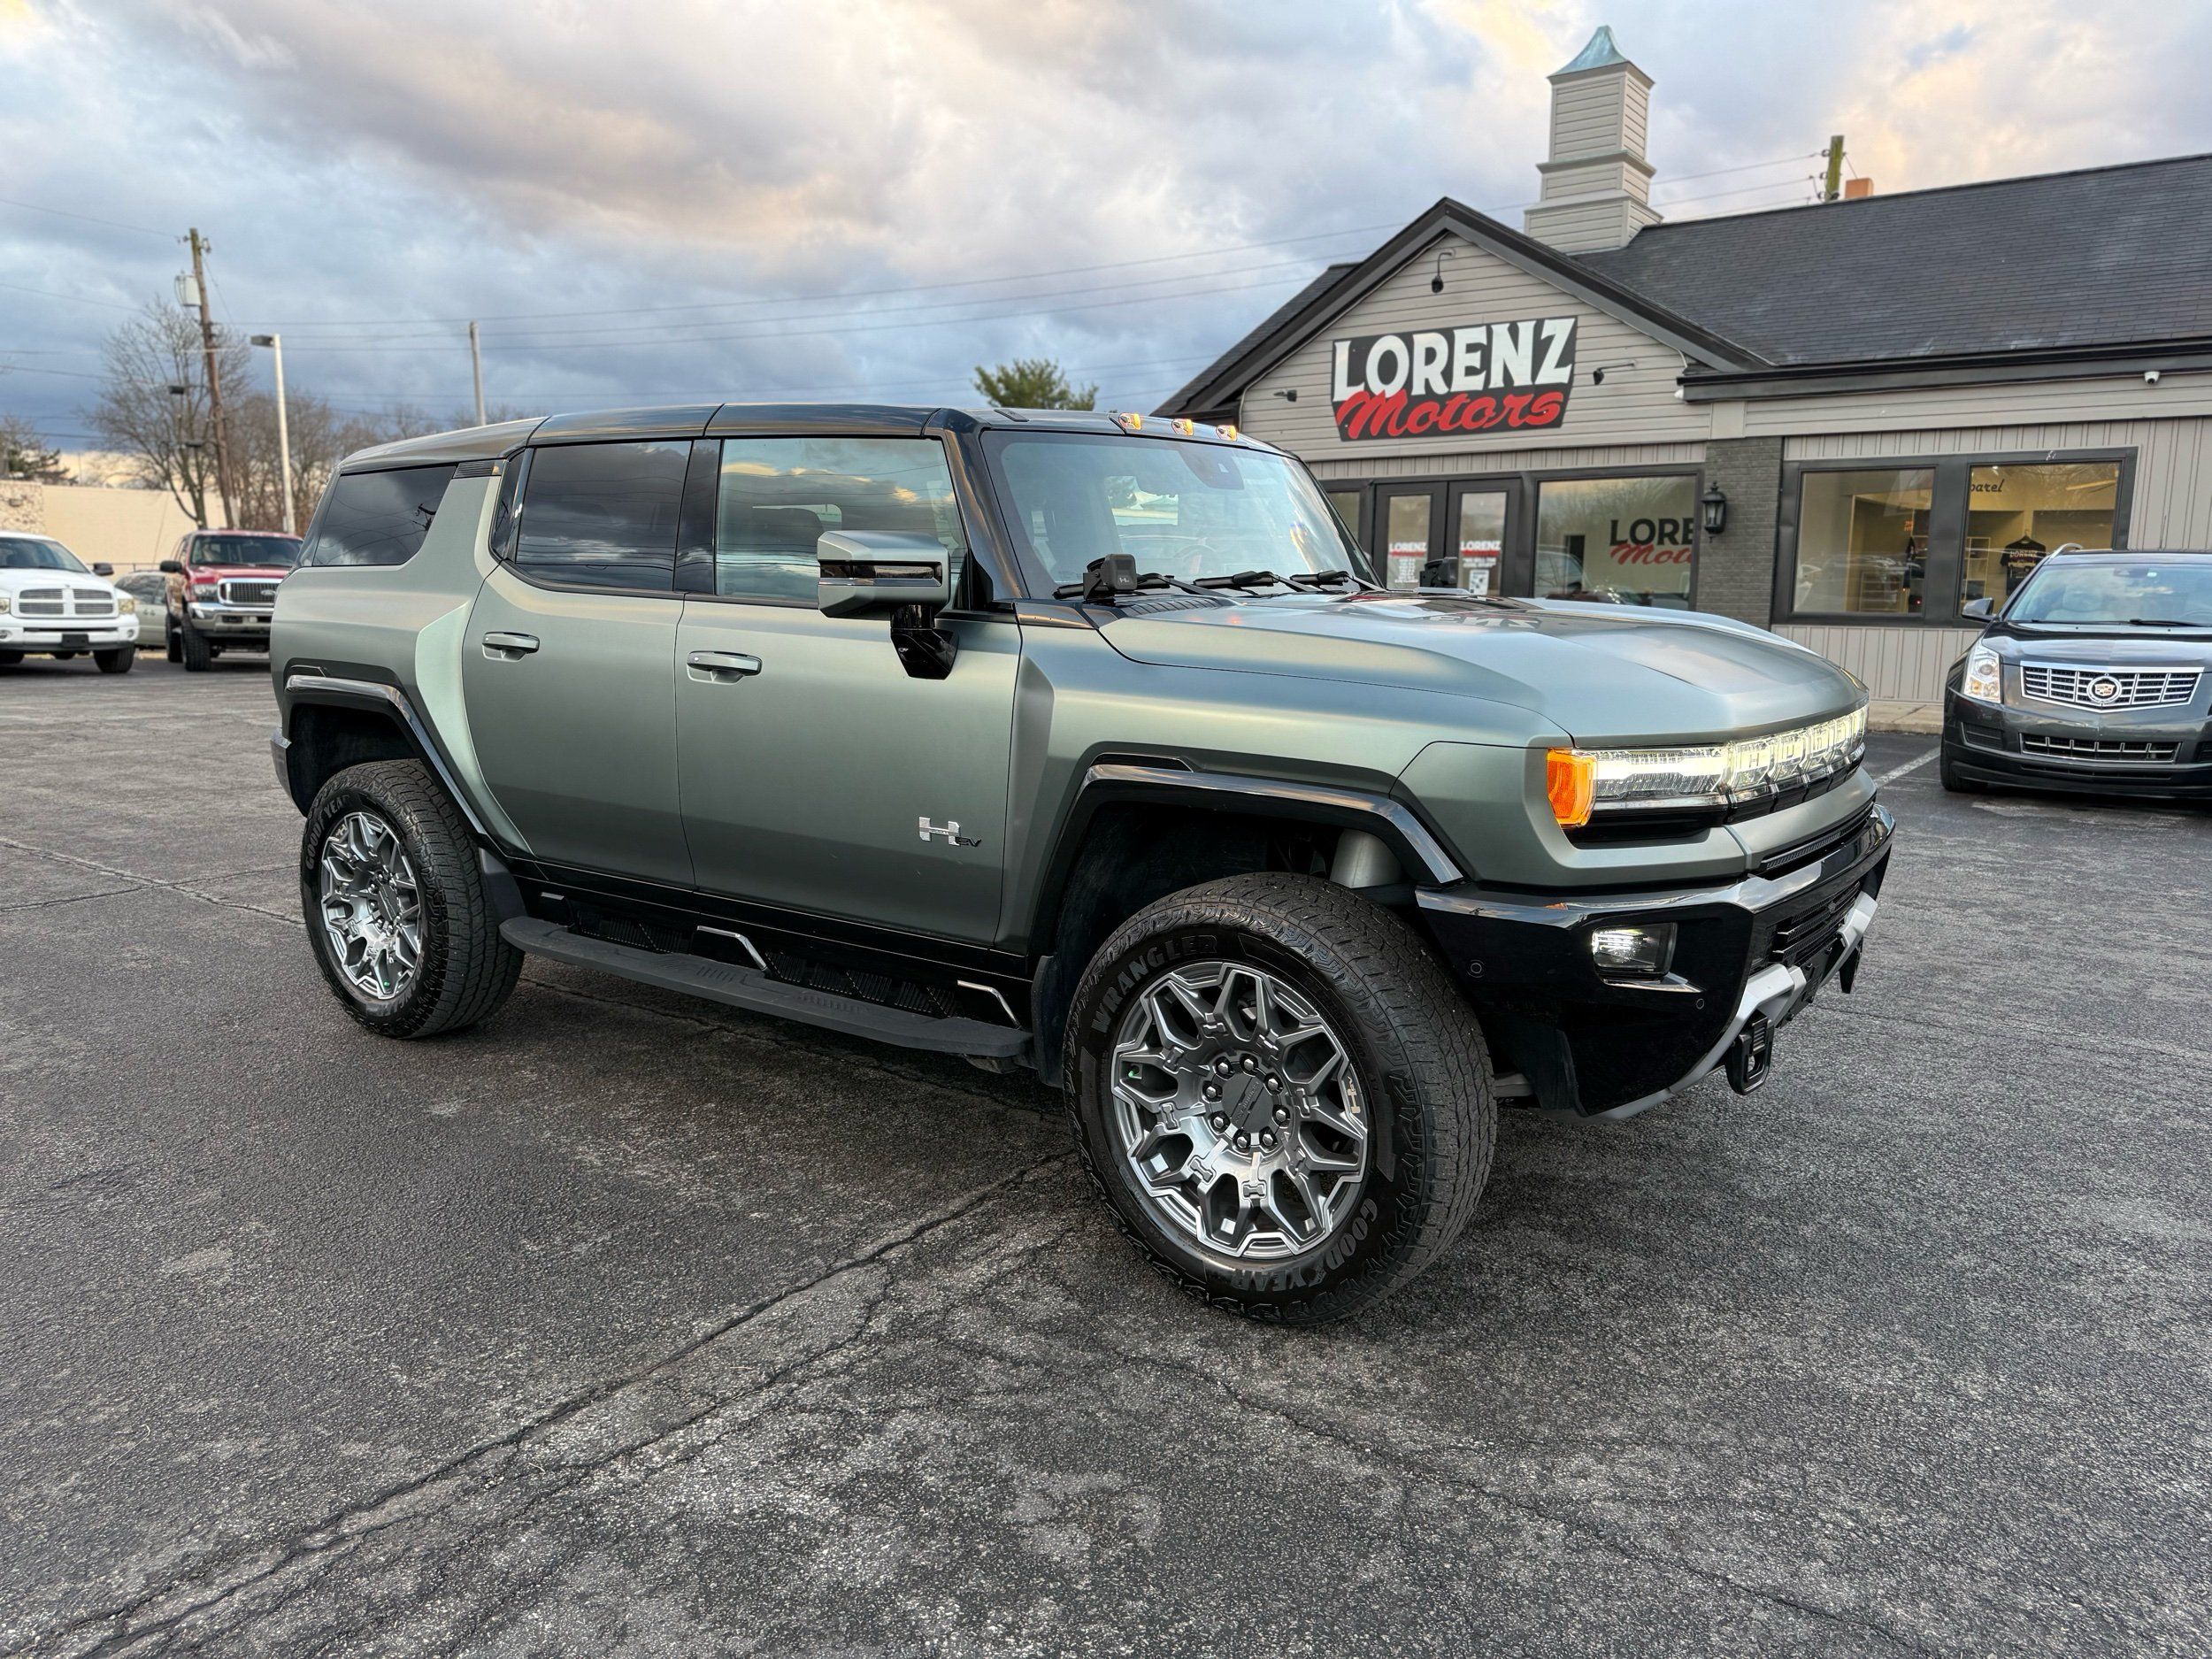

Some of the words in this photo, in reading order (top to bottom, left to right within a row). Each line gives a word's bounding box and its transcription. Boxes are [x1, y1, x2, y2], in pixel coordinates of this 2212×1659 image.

[1333, 318, 1576, 402] LORENZ
[1334, 388, 1564, 439] Motors
[1090, 934, 1217, 1033] WRANGLER
